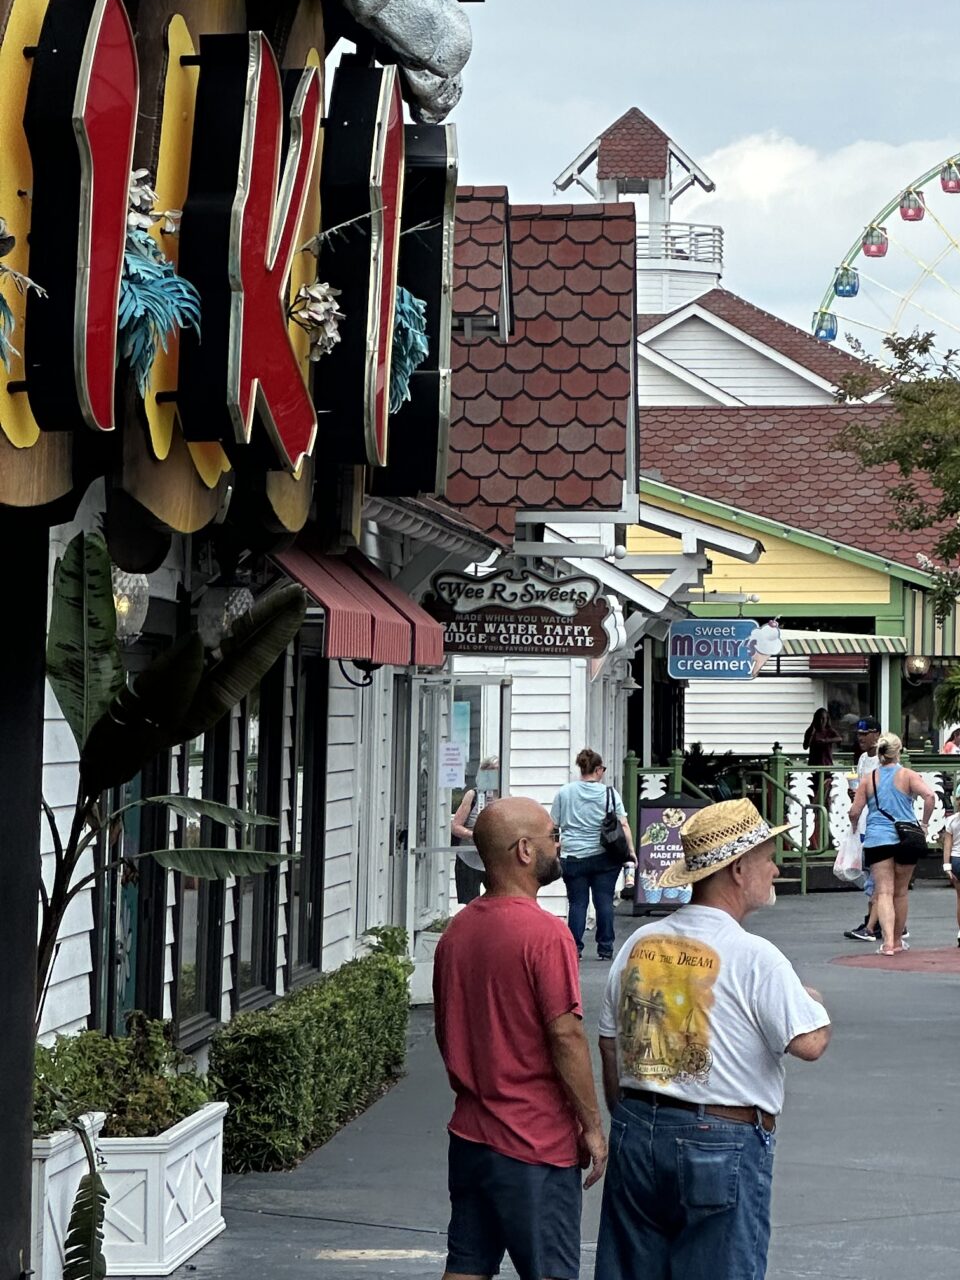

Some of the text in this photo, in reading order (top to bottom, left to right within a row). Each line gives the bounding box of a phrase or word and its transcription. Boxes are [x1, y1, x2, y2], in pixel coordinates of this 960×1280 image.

[439, 581, 588, 606] Wee R Sweets
[455, 613, 575, 625] MADE WHILE YOU WATCH
[440, 622, 592, 636] SALT WATER TAFFY
[695, 625, 736, 636] sweet
[444, 632, 595, 647] UDGE CHOCOLATE
[677, 660, 756, 675] creamery
[659, 954, 673, 964] THE
[677, 951, 713, 968] DREAM
